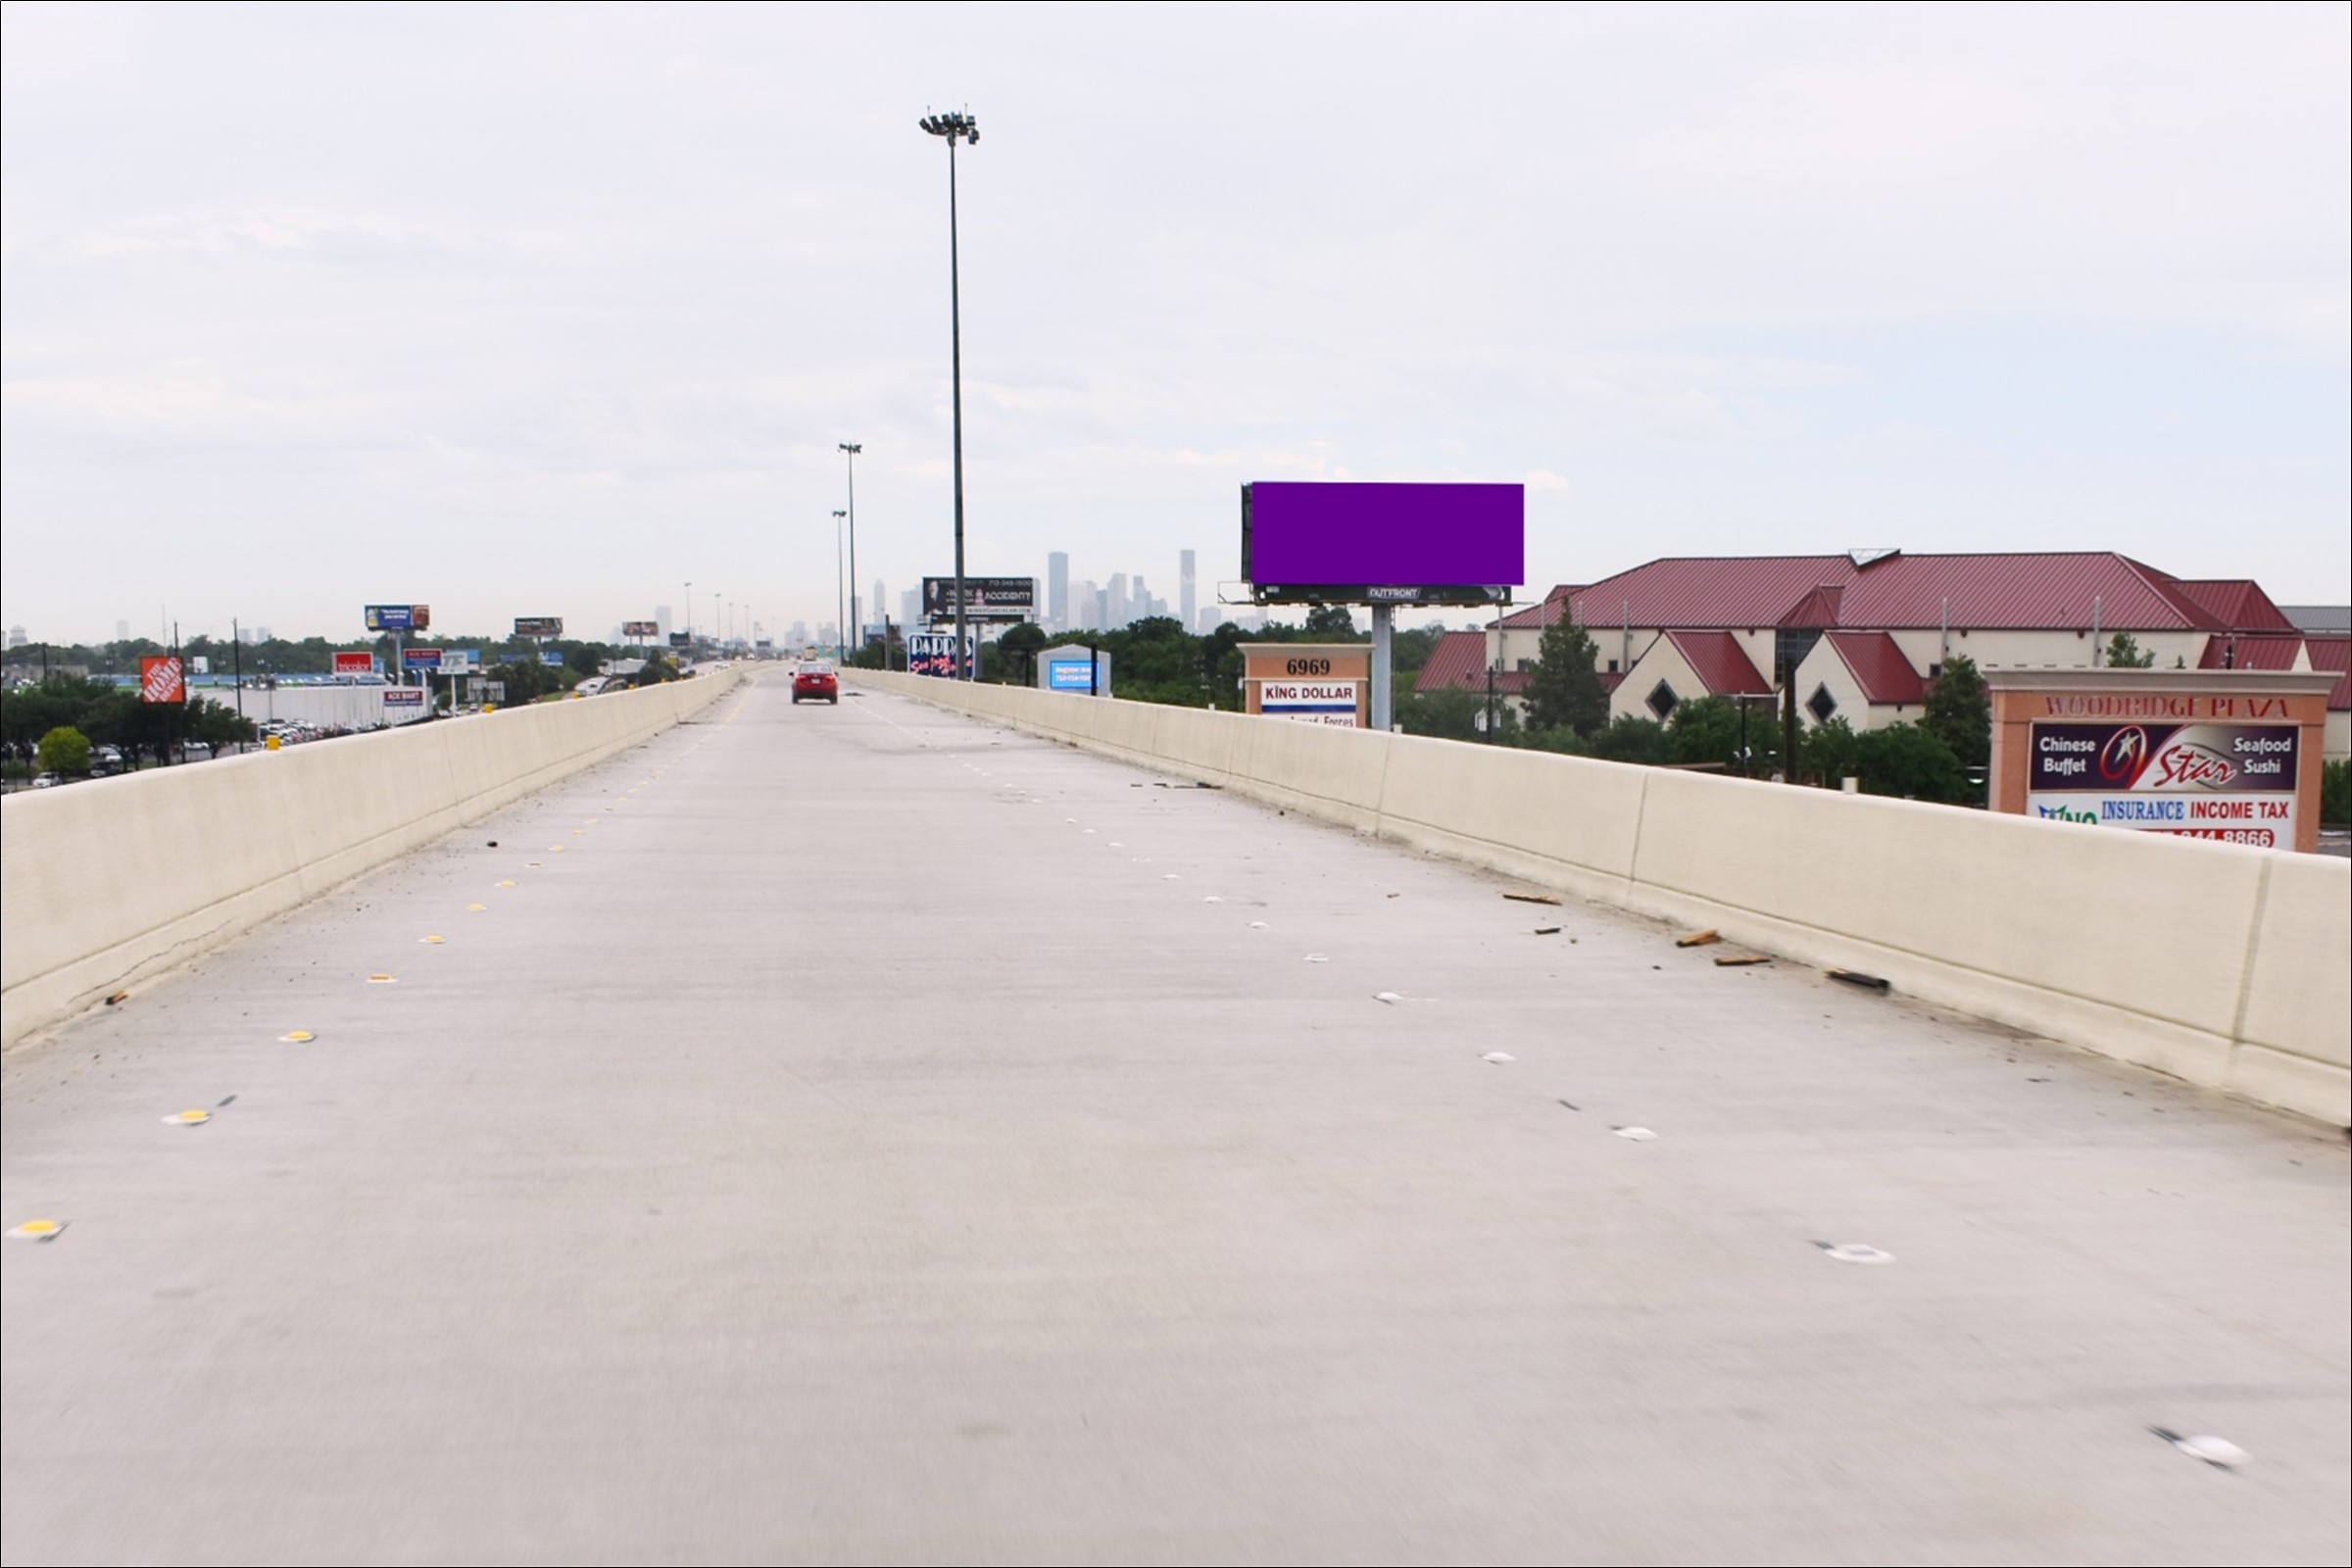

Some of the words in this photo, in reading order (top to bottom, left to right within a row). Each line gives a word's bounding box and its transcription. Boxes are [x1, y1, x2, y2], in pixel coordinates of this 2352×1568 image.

[1369, 588, 1419, 598] OUTFRONT
[147, 662, 162, 679] THE
[1286, 659, 1331, 675] 6969
[144, 658, 182, 703] HOME
[1265, 686, 1298, 699] KING
[1301, 687, 1352, 699] DOLLAR
[2045, 697, 2200, 717] WOODRIDGE
[2211, 698, 2288, 717] PLAZA
[2039, 736, 2096, 752] Chinese
[2233, 737, 2292, 756] Seafood
[2043, 758, 2086, 776] Buffet
[2153, 745, 2237, 787] Star
[2243, 759, 2281, 773] Sushi
[2101, 801, 2184, 820] INSURANCE
[2190, 802, 2254, 819] INCOME
[2258, 802, 2289, 819] TAX
